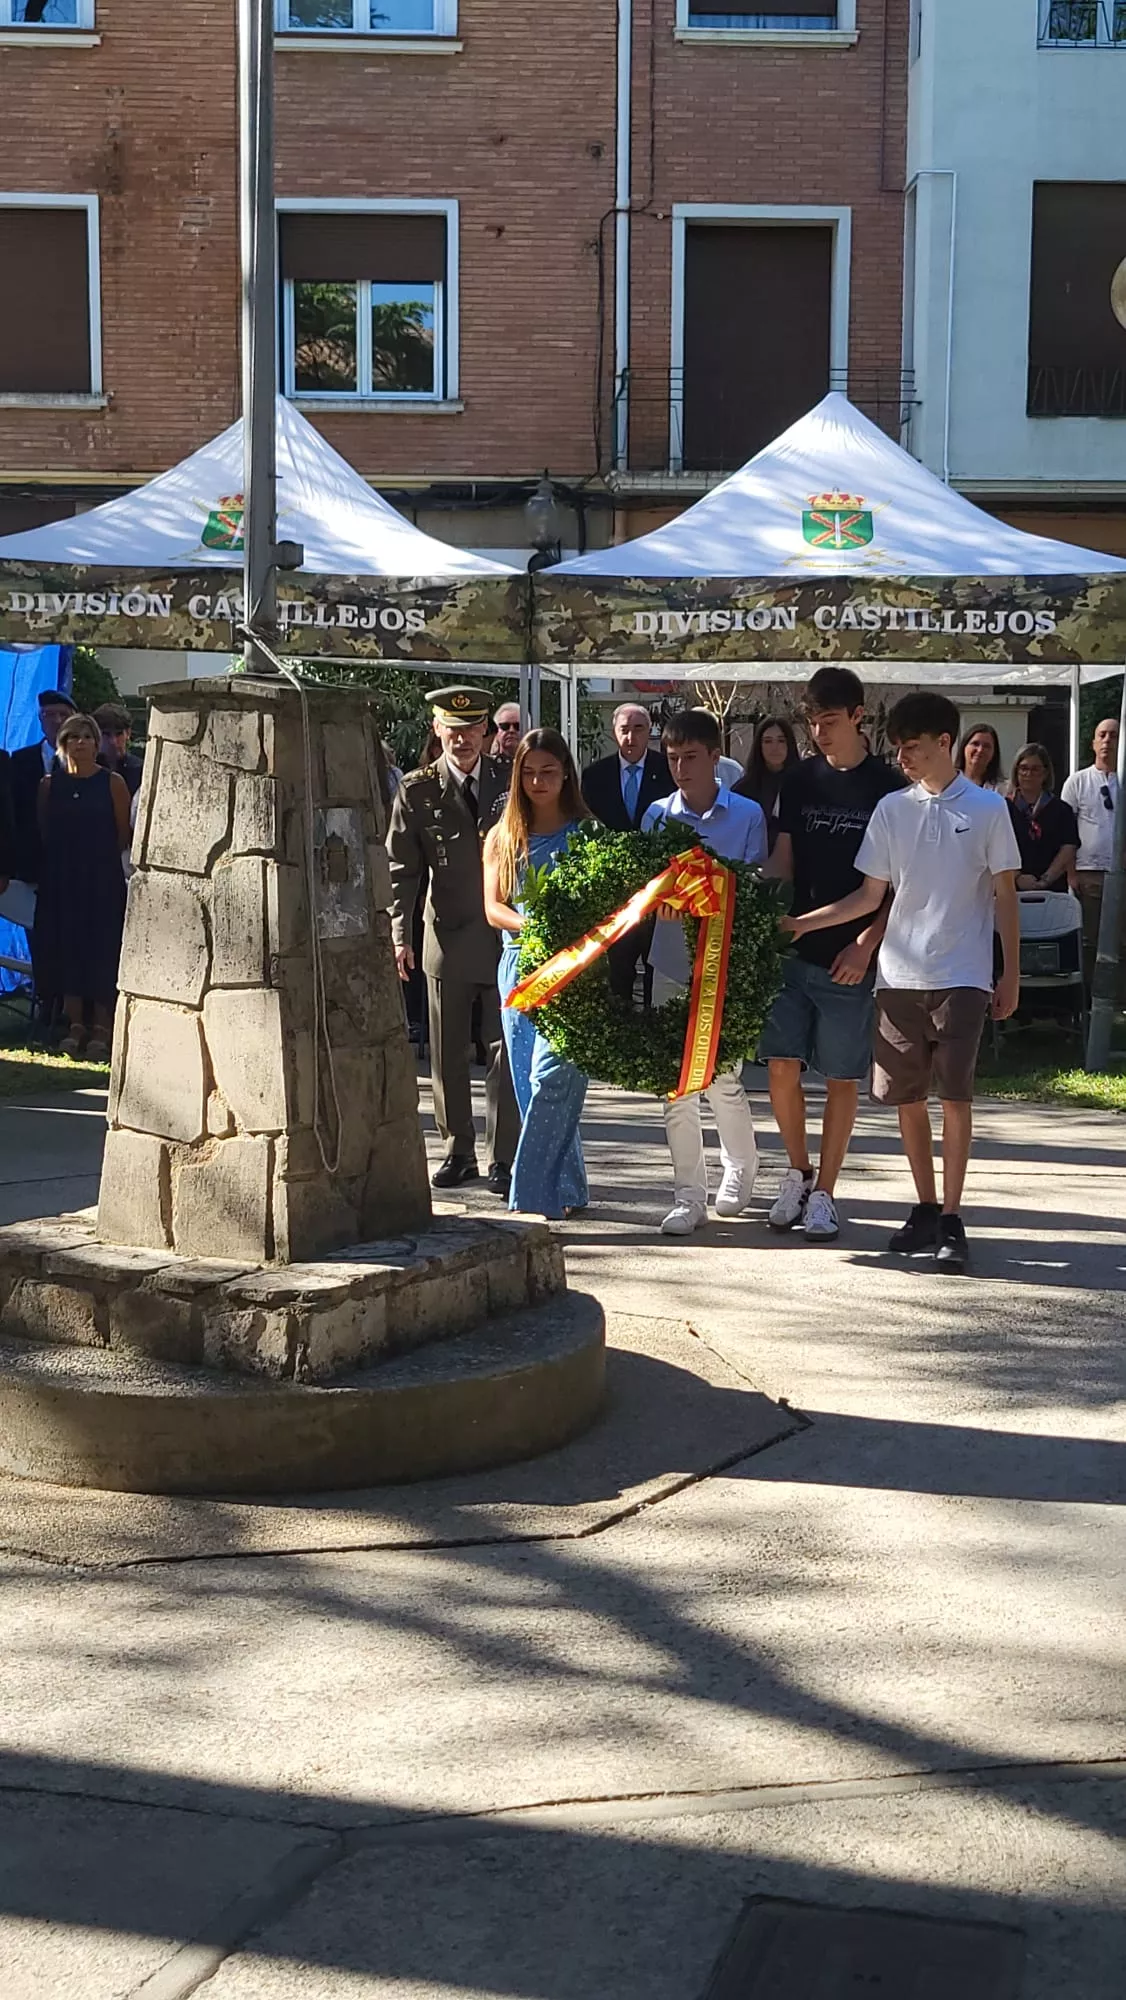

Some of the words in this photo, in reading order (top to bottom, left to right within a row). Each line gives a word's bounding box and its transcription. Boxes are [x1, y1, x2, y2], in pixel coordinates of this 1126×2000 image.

[8, 587, 173, 618] DIVISIÓN
[188, 594, 427, 632] CASILLEJOS
[632, 601, 799, 635] DIVISIÓN
[813, 605, 1057, 635] CASTILLEJOS
[700, 1003, 714, 1032] LOS
[696, 1035, 710, 1064] QUE
